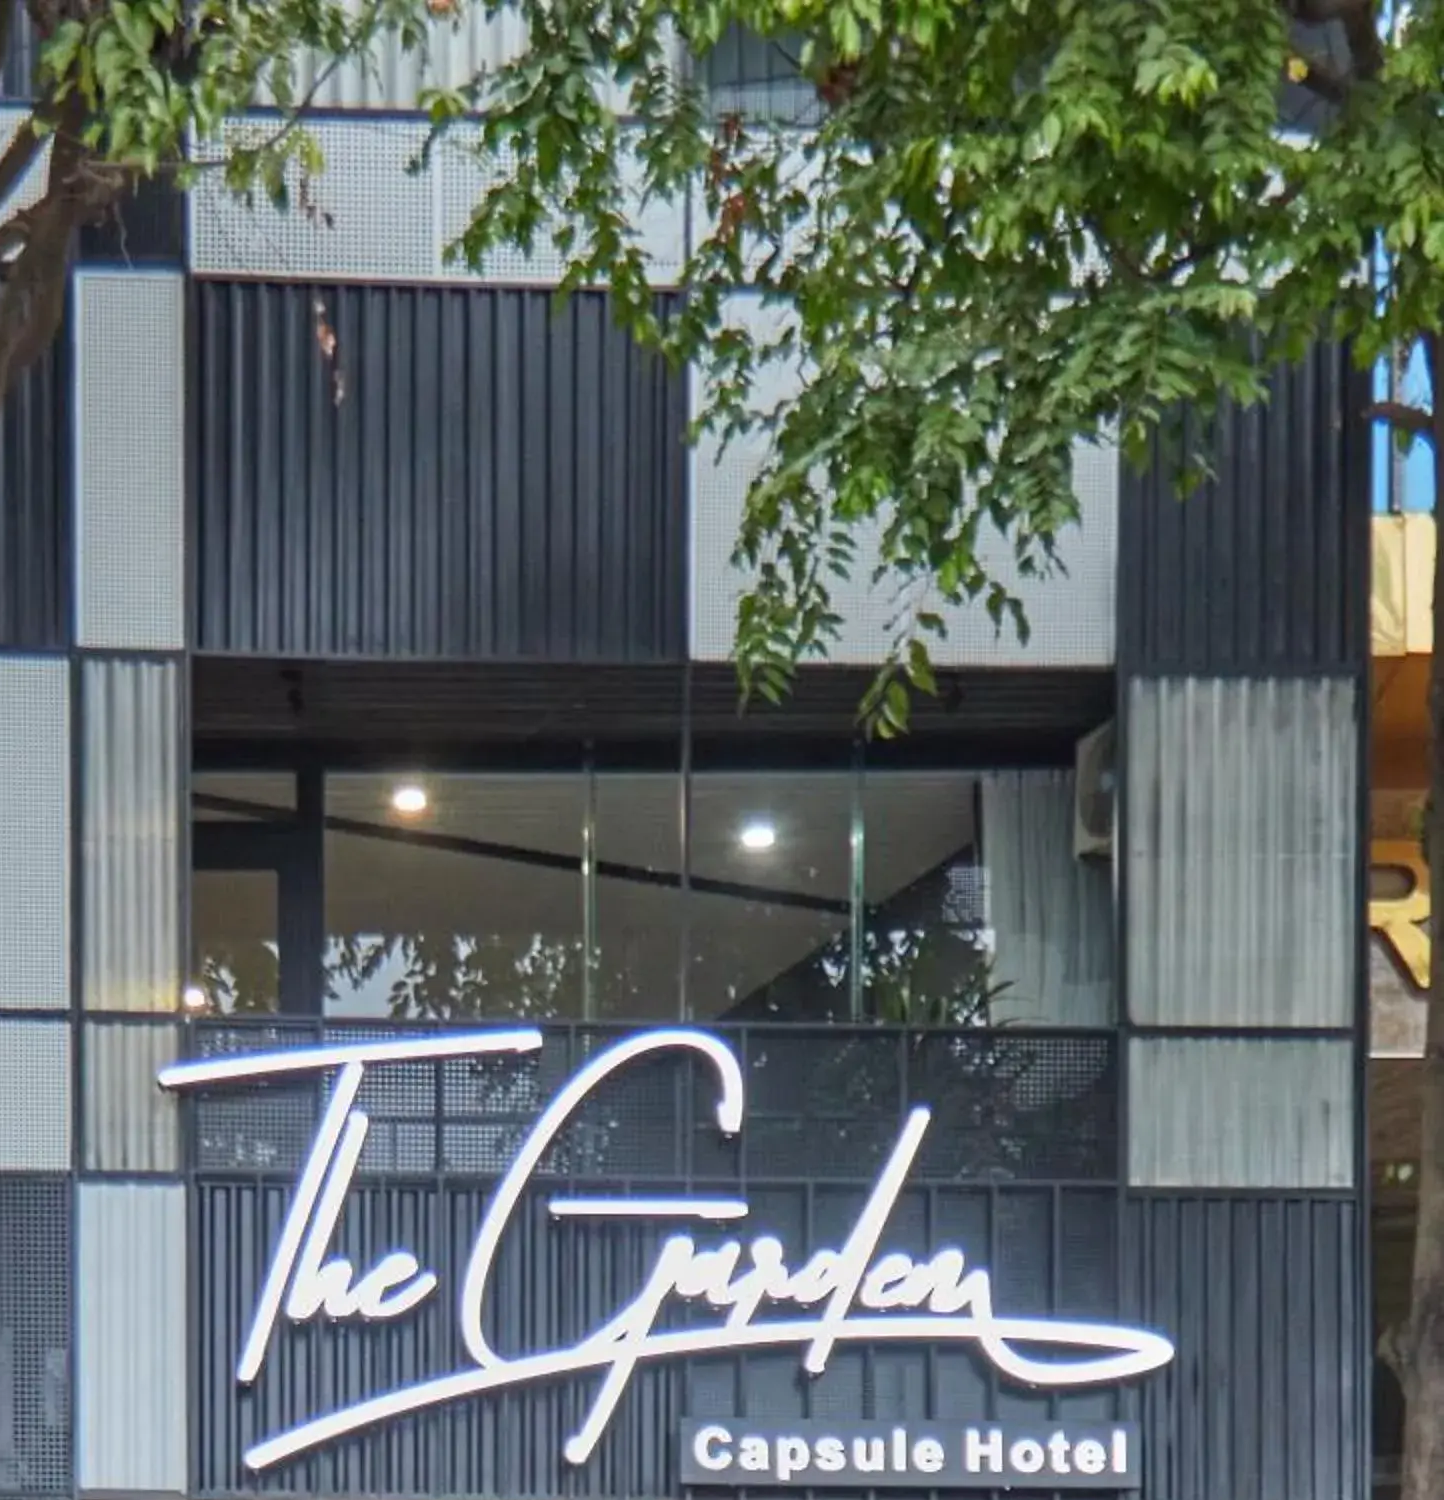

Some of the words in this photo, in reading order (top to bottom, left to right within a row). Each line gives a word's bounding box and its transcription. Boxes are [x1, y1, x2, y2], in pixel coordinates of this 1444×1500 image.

[158, 1027, 543, 1383] The
[243, 1028, 1175, 1468] Garden
[693, 1425, 945, 1481] Capsule
[965, 1428, 1127, 1473] Hotel
